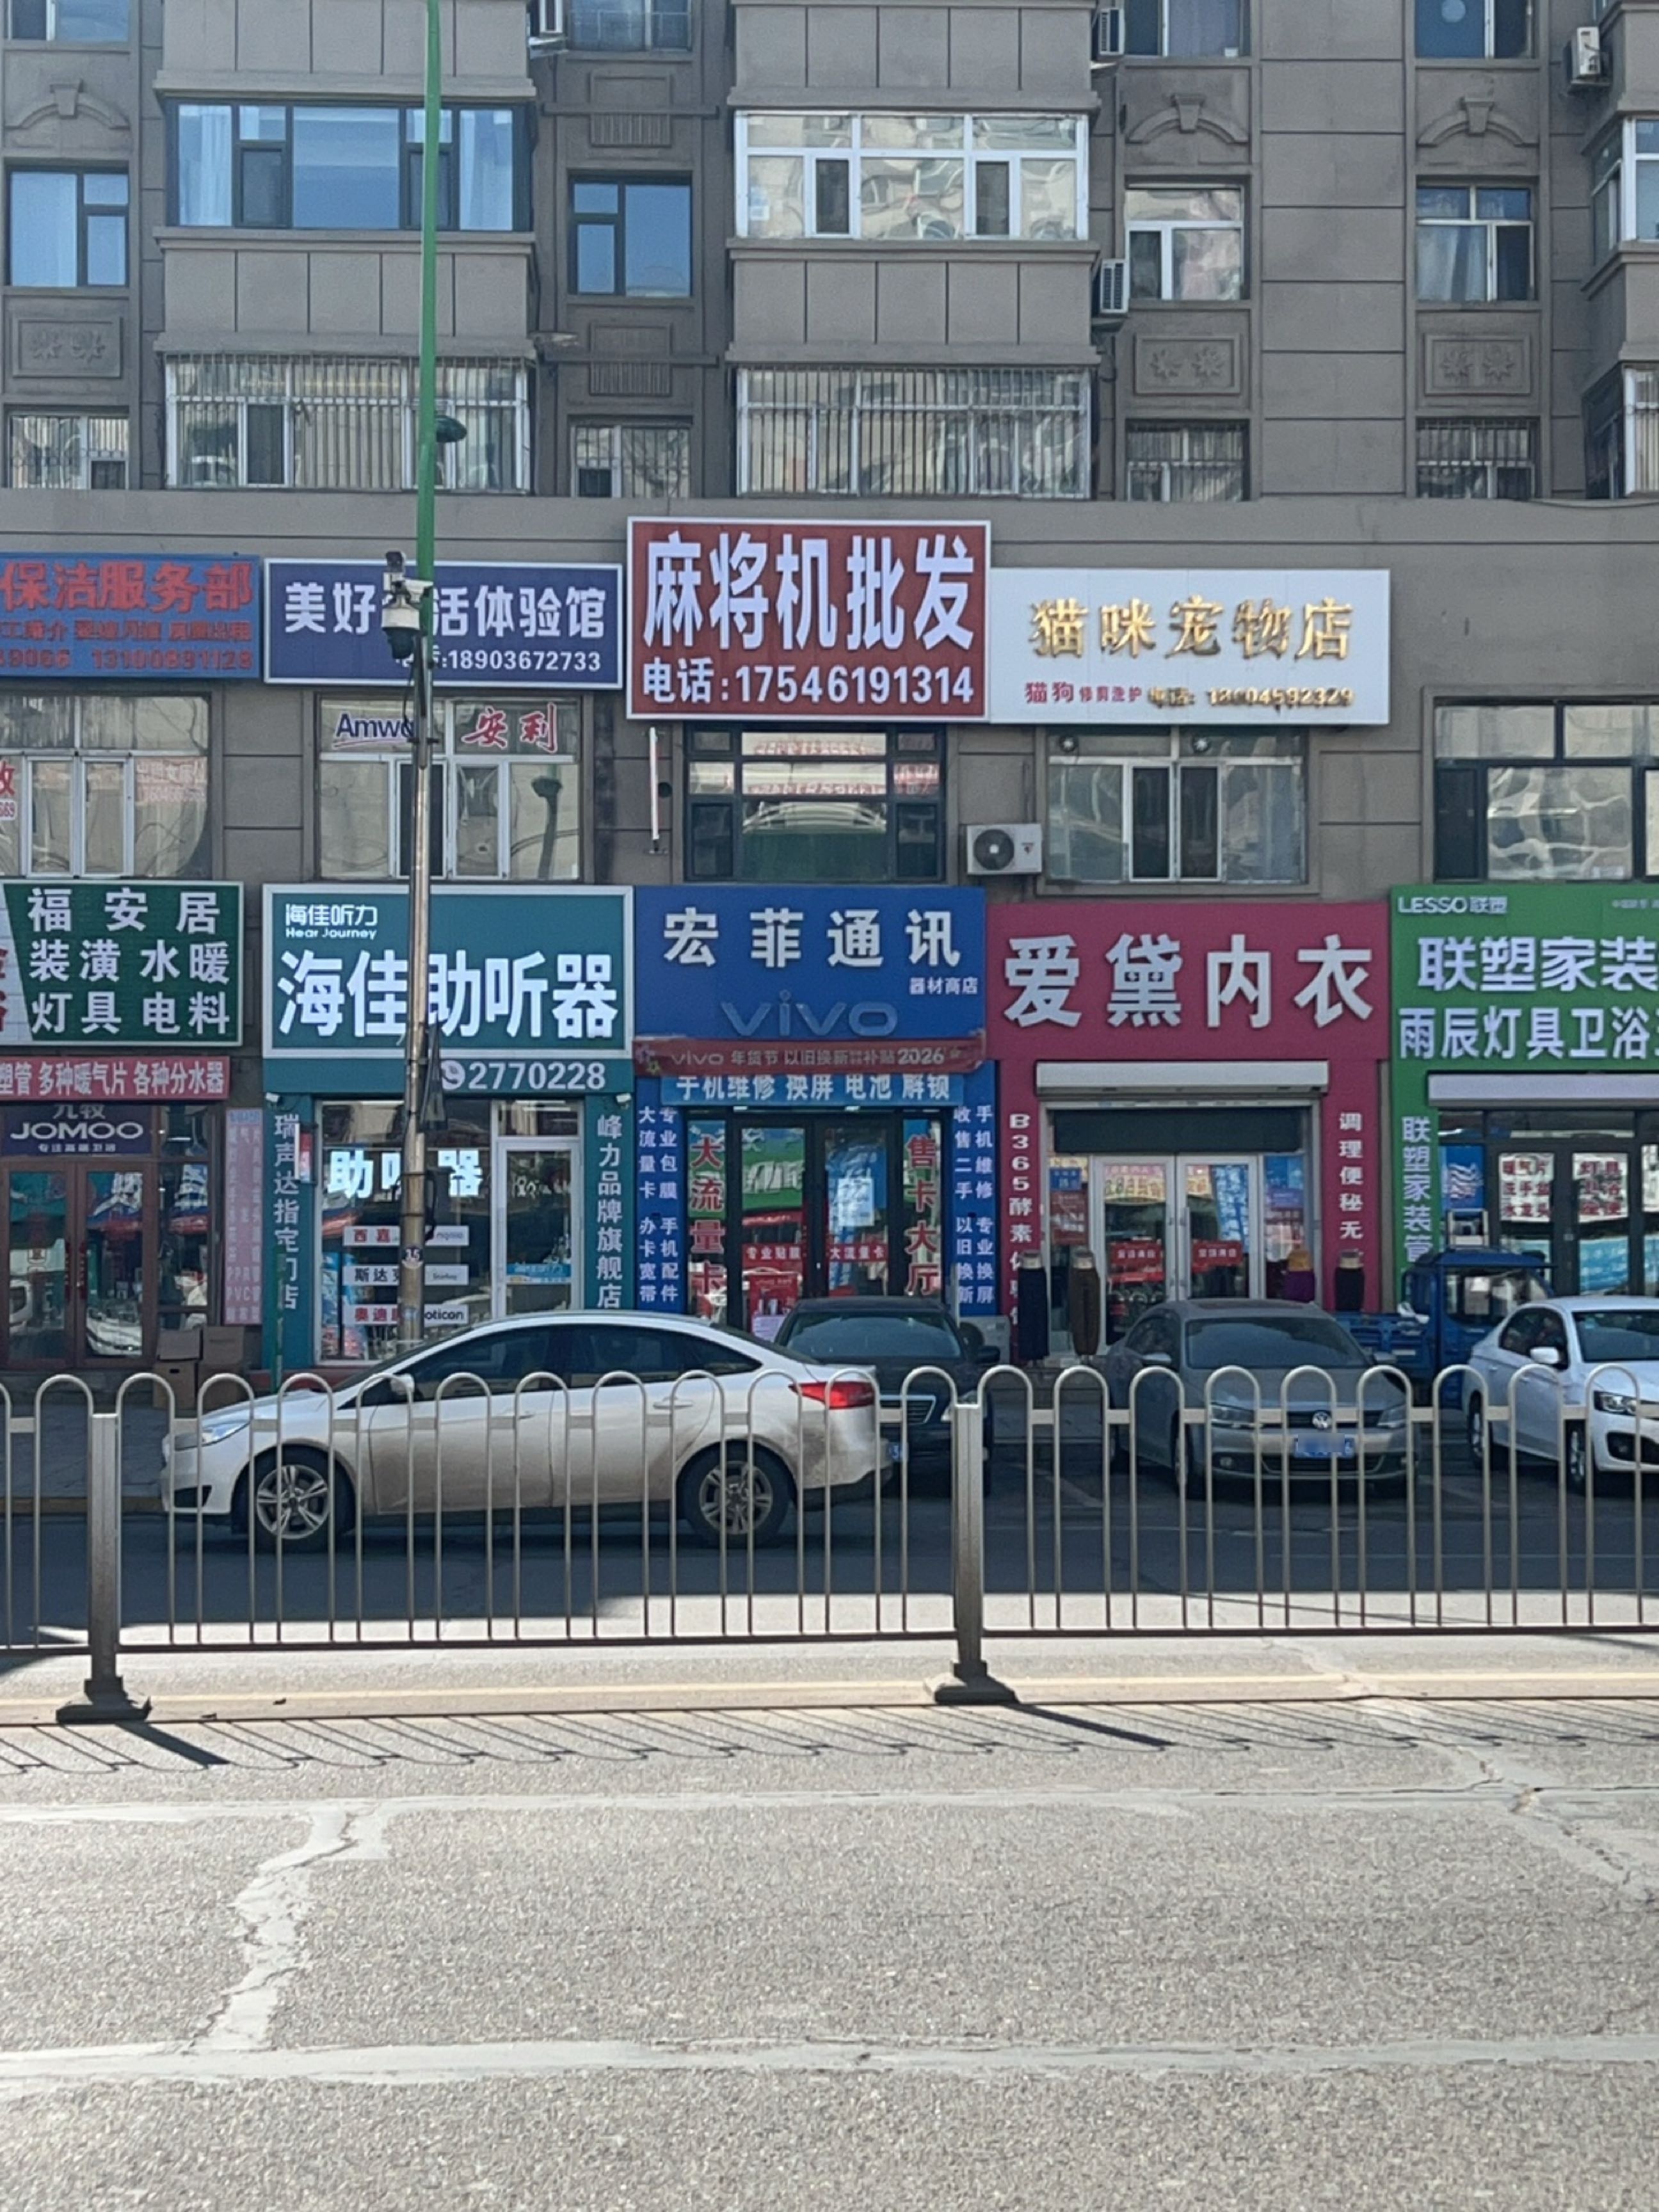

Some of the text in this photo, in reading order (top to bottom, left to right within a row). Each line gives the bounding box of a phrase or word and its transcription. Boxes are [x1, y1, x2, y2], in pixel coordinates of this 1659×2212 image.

[0, 562, 253, 613] 保洁服务部
[284, 582, 605, 639] 美好活体验馆
[644, 531, 974, 651] 麻将机批发
[1030, 596, 1353, 659] 猫咪宠物店
[395, 644, 601, 672] :18903672733
[643, 657, 974, 703] 电话:17546191314
[461, 702, 557, 753] 安利
[28, 888, 221, 934] 福安居
[285, 904, 378, 927] 海佳听力
[285, 927, 378, 940] Hear Journey
[663, 907, 961, 968] 宏菲通讯
[29, 938, 230, 984] 装潢水暖
[910, 977, 978, 995] 器材商店
[1004, 934, 1374, 1028] 爱黛内衣
[1418, 936, 1659, 991] 联塑家装
[31, 991, 230, 1034] 灯具电料
[277, 949, 619, 1038] 海佳助听器
[721, 989, 898, 1036] vivo
[1399, 1005, 1659, 1060] 雨辰灯具卫浴
[133, 1061, 223, 1096] 各种分水器
[469, 1062, 606, 1090] 2770228
[10, 1122, 144, 1139] JOMOO
[639, 1106, 656, 1199] 大流量卡
[597, 1114, 623, 1309] 峰力品牌旗舰店
[1338, 1112, 1364, 1256] 调理便秘无
[1401, 1116, 1433, 1263] 联塑家装管
[689, 1133, 726, 1298] 大流量卡
[904, 1133, 941, 1297] 售卡大厅
[1008, 1113, 1033, 1324] B365酵素
